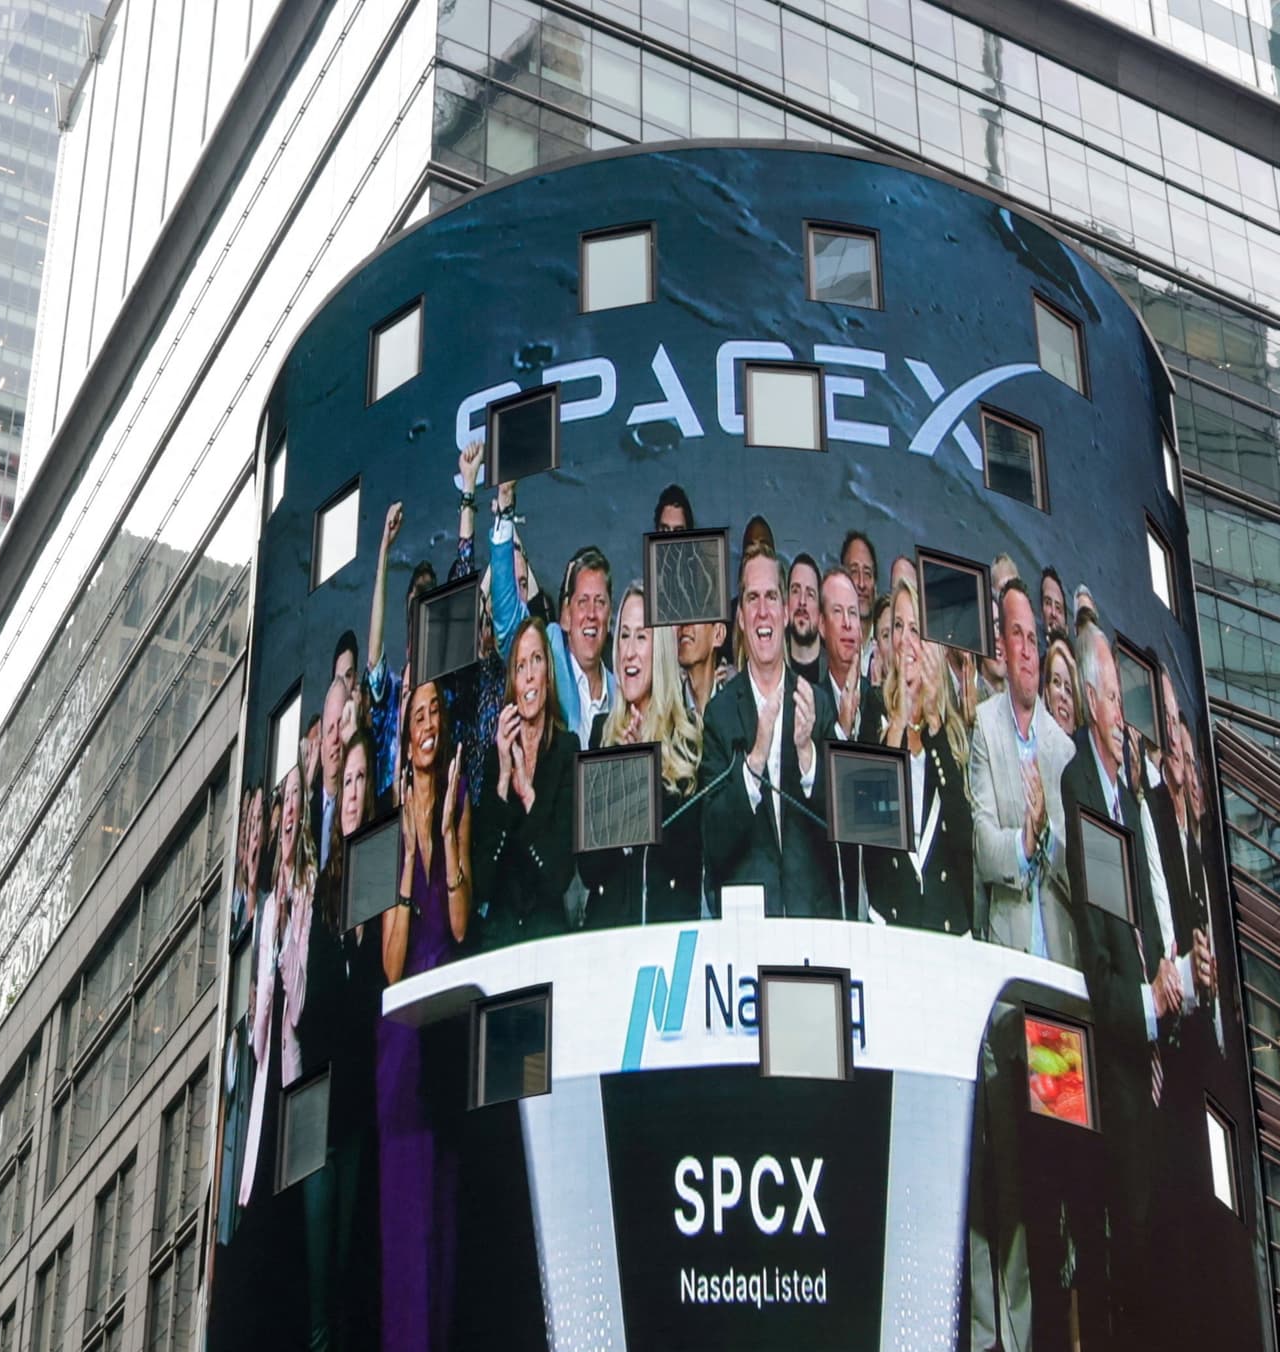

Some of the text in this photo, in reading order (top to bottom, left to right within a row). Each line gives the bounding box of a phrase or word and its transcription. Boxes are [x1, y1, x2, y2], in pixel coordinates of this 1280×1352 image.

[705, 957, 866, 1050] Naq
[673, 1154, 827, 1236] SPCX
[679, 1266, 827, 1308] NasdaqListed
